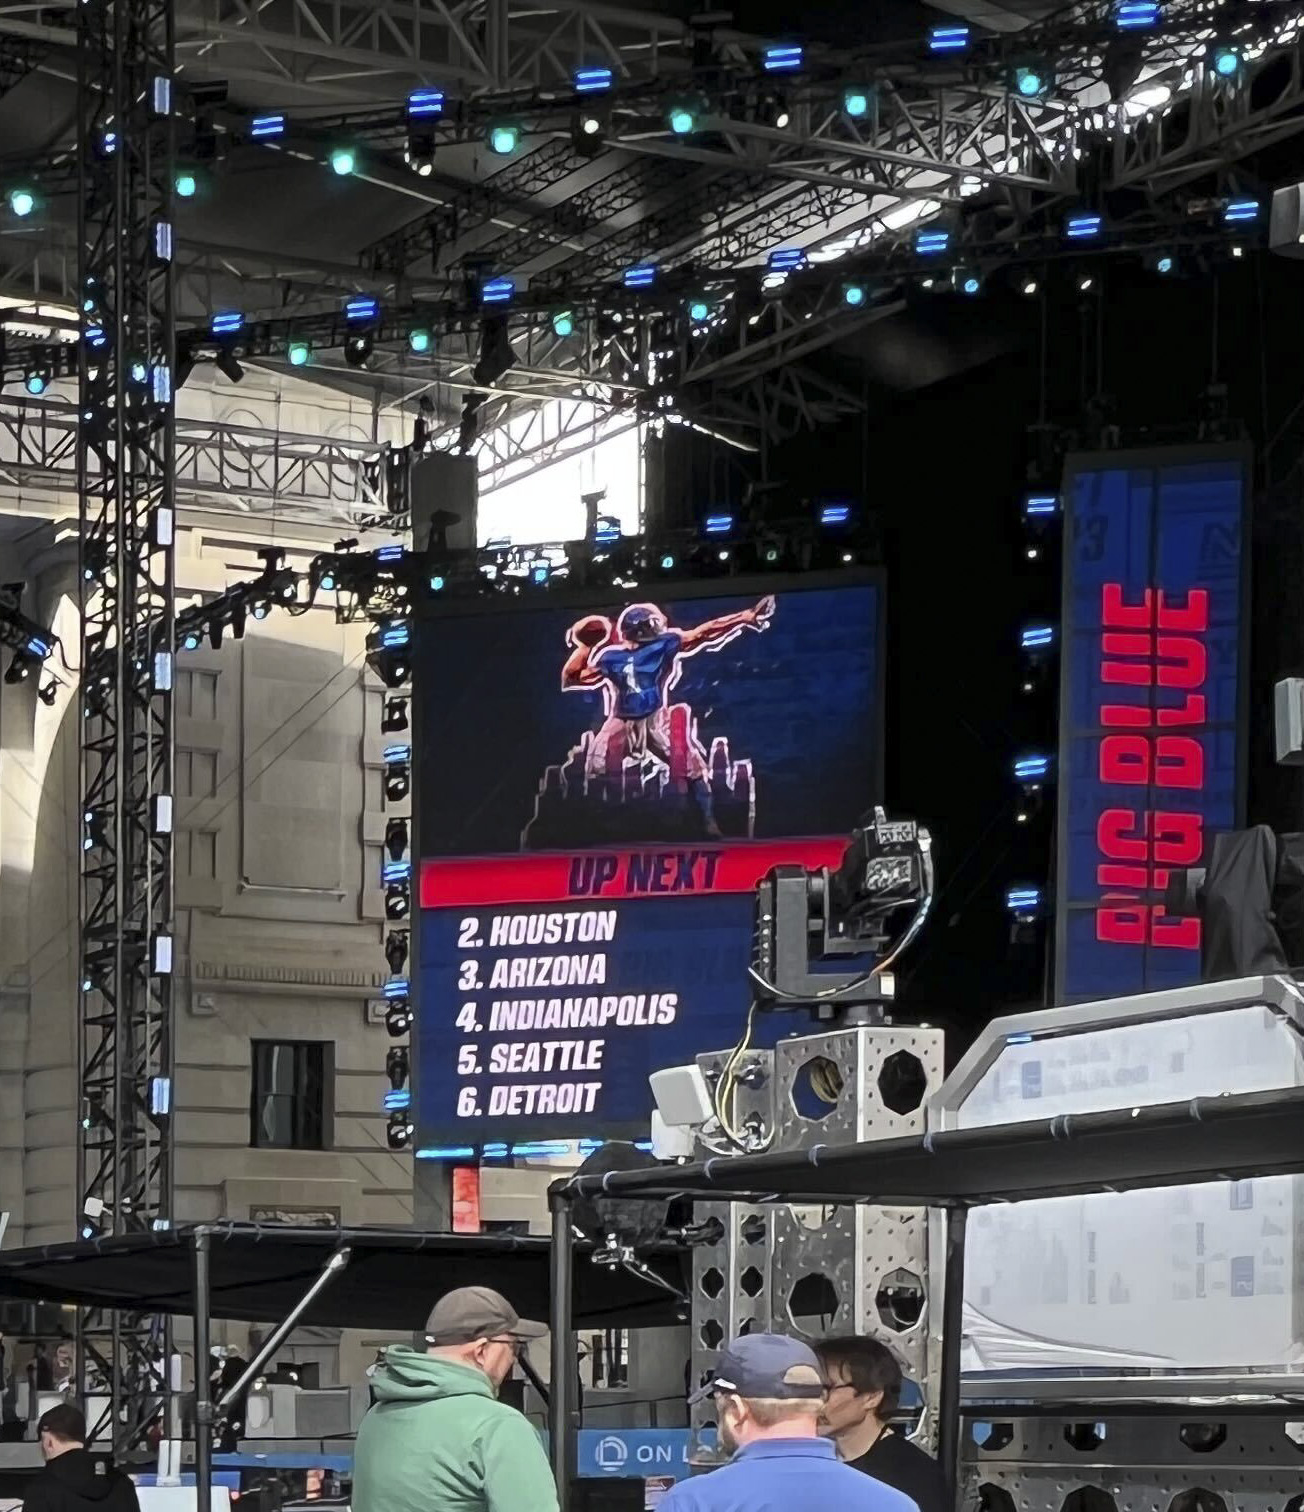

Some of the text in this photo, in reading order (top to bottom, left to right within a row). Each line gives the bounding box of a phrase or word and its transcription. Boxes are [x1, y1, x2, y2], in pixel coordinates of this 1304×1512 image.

[1099, 582, 1208, 790] BLUE
[568, 850, 723, 895] UP NEXT
[457, 910, 617, 949] 2. HOUSTON
[458, 953, 607, 991] 3. ARIZONA
[455, 993, 678, 1033] 4. INDIANAPOLIS
[457, 1039, 605, 1075] 5. SEATTLE
[456, 1082, 602, 1118] 6. DETROIT
[637, 1445, 672, 1463] ON
